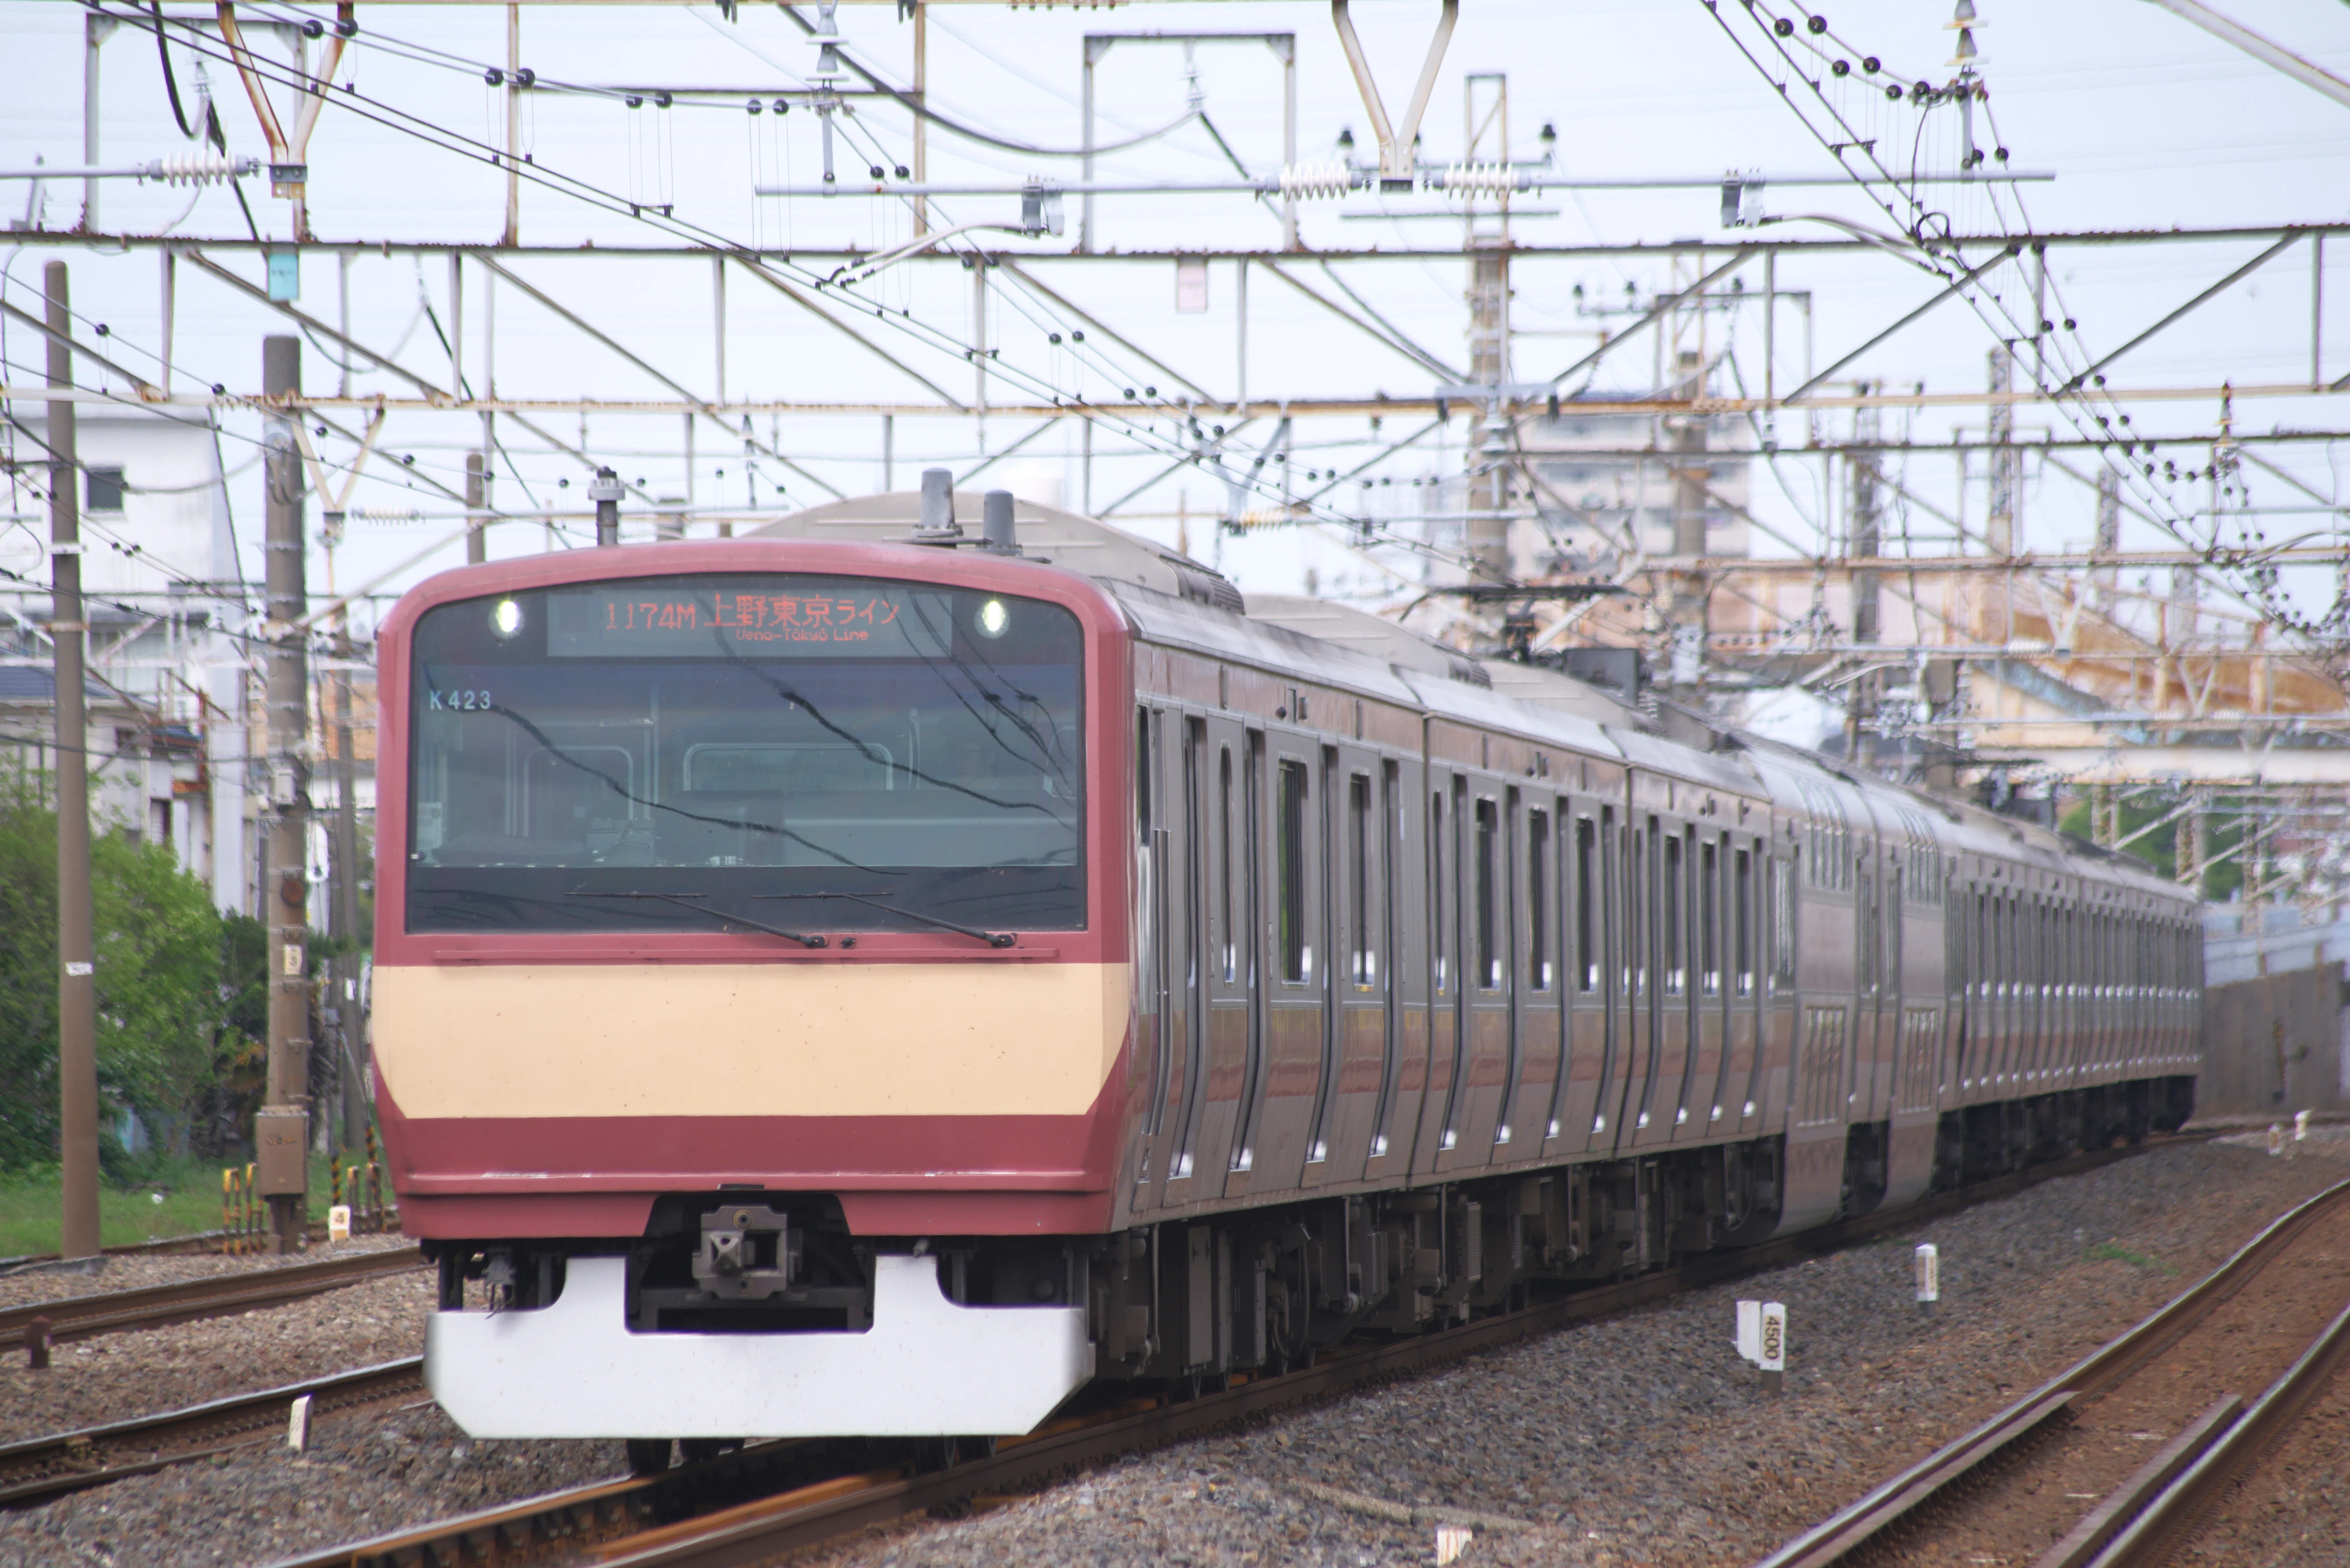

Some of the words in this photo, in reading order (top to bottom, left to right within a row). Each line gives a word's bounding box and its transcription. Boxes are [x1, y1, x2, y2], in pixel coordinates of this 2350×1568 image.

[606, 602, 696, 630] 1174M
[704, 593, 898, 628] 上野東京ライン
[834, 628, 868, 641] Line
[429, 690, 491, 710] K423
[1765, 1316, 1779, 1360] 4500
